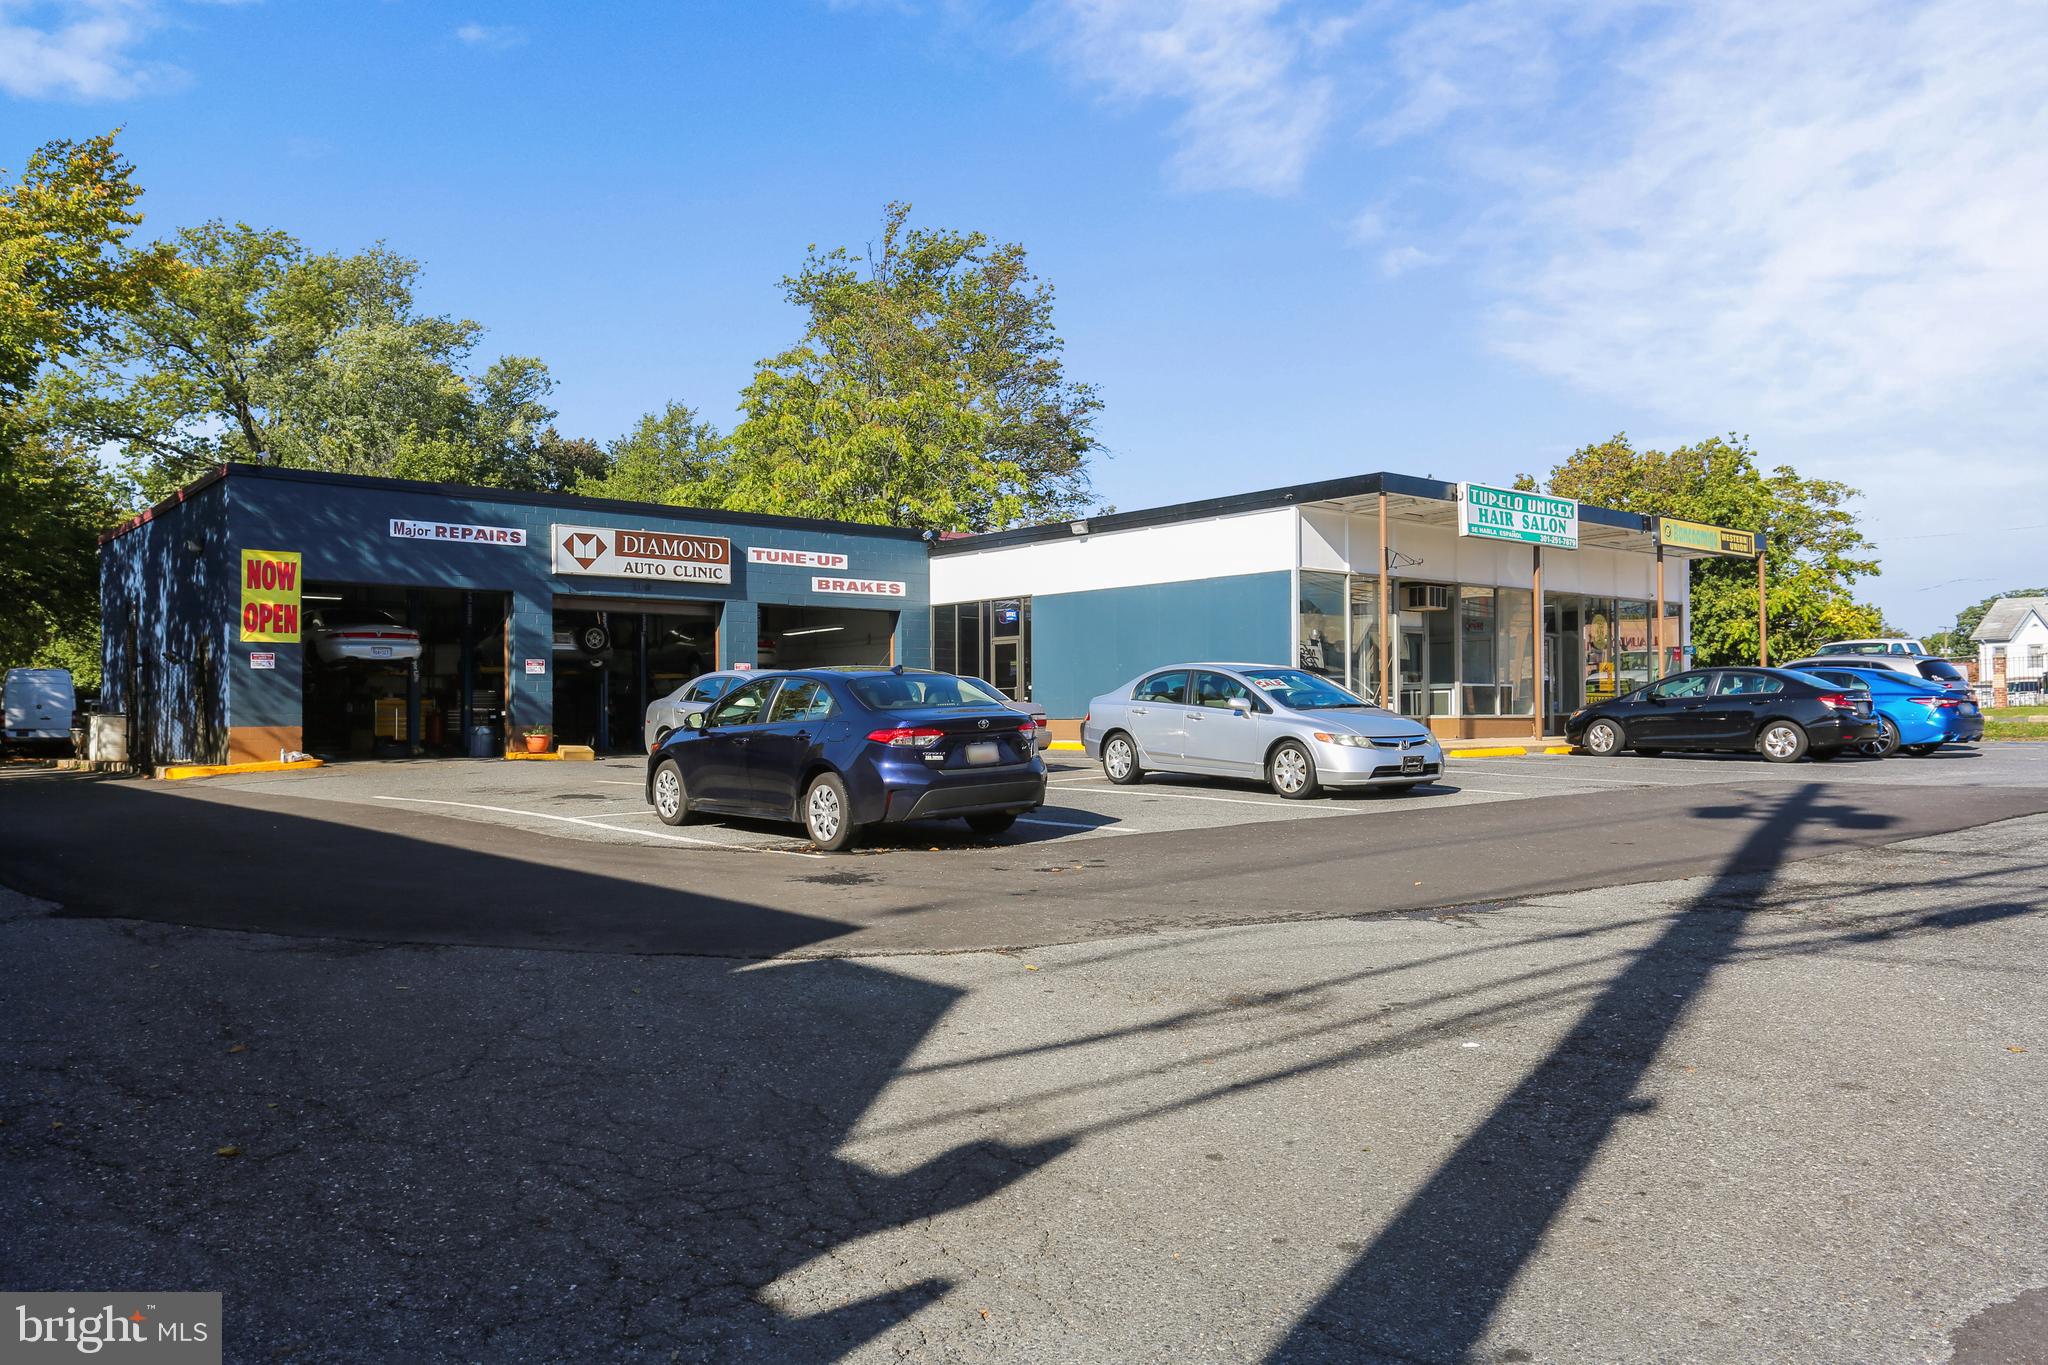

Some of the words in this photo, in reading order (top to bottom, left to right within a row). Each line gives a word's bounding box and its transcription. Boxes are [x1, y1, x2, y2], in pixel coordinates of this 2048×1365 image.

[1470, 488, 1523, 511] TUPELO
[1527, 499, 1573, 519] UNISEX
[1477, 507, 1515, 527] HAIR
[1522, 514, 1567, 535] SALON
[1479, 527, 1498, 536] HABLA
[393, 521, 431, 538] Major
[435, 525, 522, 544] REPAIRS
[1721, 532, 1748, 544] WESTERN
[622, 535, 724, 560] DIAMOND
[752, 549, 844, 567] TUNE-UP
[1729, 543, 1749, 553] UNION
[246, 559, 297, 592] NOW
[623, 561, 666, 575] AUTO
[672, 565, 724, 580] CLINIC
[817, 579, 901, 595] BRAKES
[243, 602, 298, 634] OPEN
